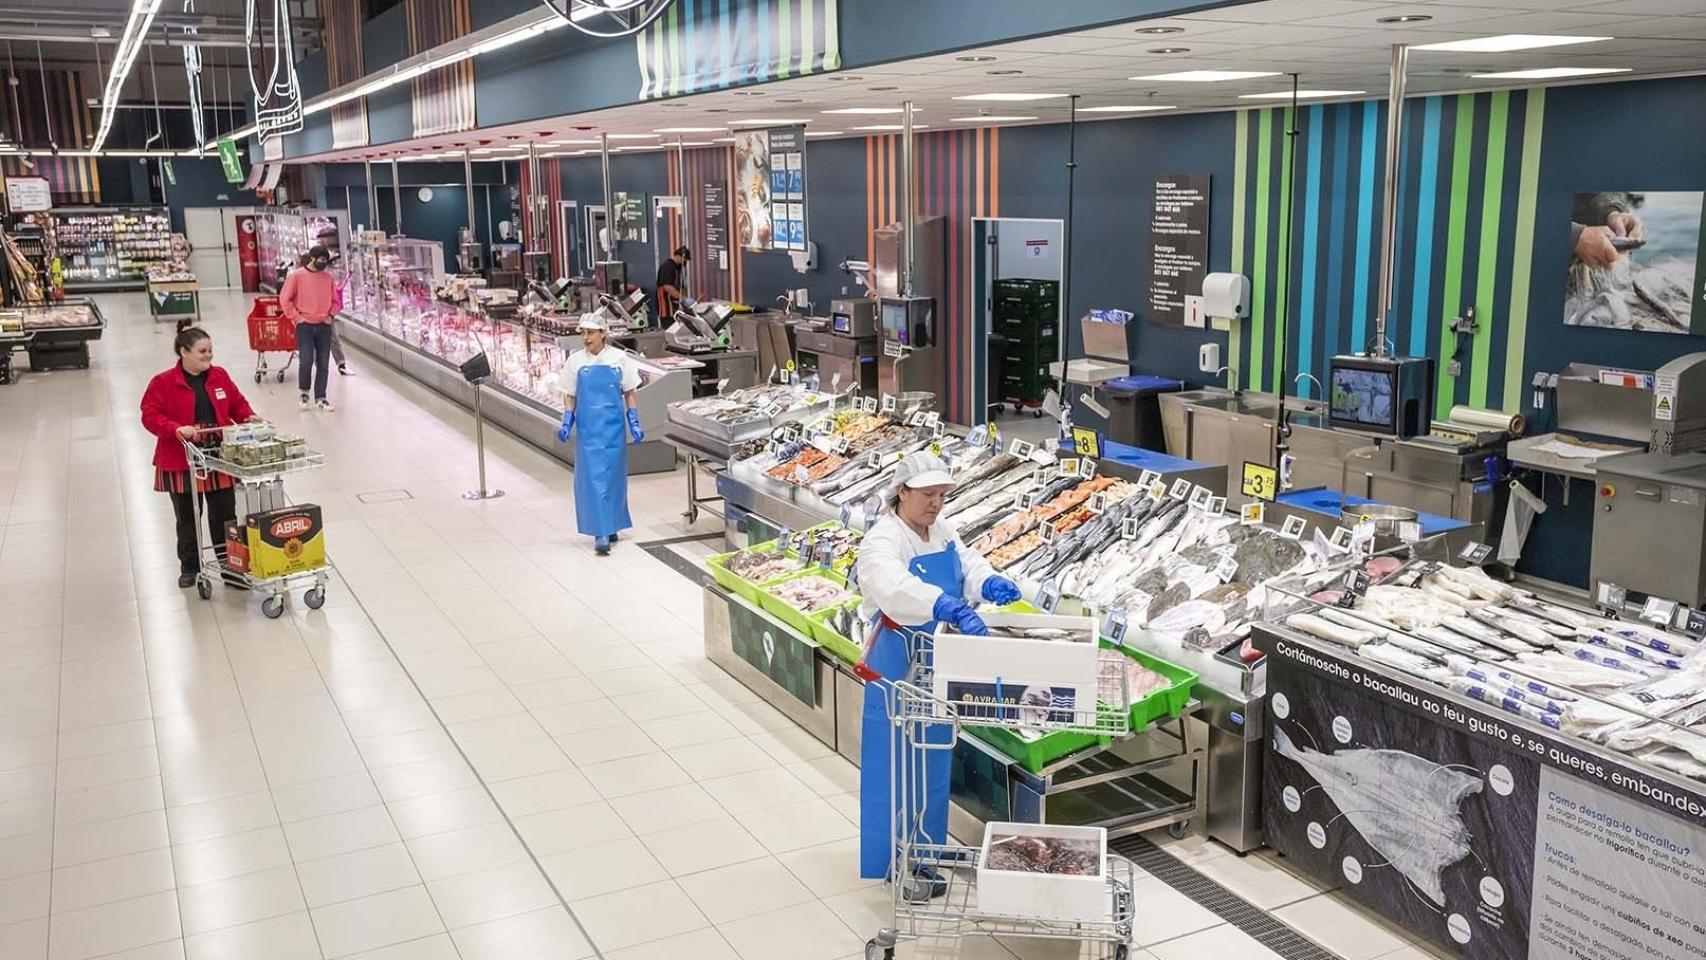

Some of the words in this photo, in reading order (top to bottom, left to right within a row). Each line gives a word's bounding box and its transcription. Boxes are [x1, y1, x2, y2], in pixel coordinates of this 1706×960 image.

[276, 518, 309, 536] ABRIL
[1276, 641, 1350, 679] Cortámosche
[1352, 672, 1360, 683] o
[1363, 672, 1419, 706] bacallau
[1422, 699, 1440, 714] ao
[1443, 704, 1465, 724] teu
[1468, 716, 1508, 740] gusto
[1511, 734, 1525, 748] e,
[1528, 739, 1545, 755] se
[1550, 748, 1609, 780] queres,
[1544, 842, 1577, 865] Trucos:
[1546, 813, 1592, 838] permanecer
[1594, 833, 1604, 843] no
[1648, 857, 1681, 877] durante
[1548, 792, 1576, 810] Como
[1579, 804, 1632, 833] desalga-lo
[1635, 827, 1690, 857] bacallau?
[1556, 807, 1576, 821] auga
[1578, 816, 1596, 829] para
[1636, 841, 1650, 852] ten
[1652, 848, 1669, 861] que
[1546, 874, 1569, 892] Podes
[1617, 911, 1651, 931] cubiños
[1653, 927, 1665, 938] de
[1667, 934, 1684, 946] xeo
[1547, 856, 1568, 871] Antes
[1569, 866, 1580, 876] de
[1660, 908, 1672, 919] sal
[1673, 915, 1691, 928] con
[1539, 932, 1567, 951] durante
